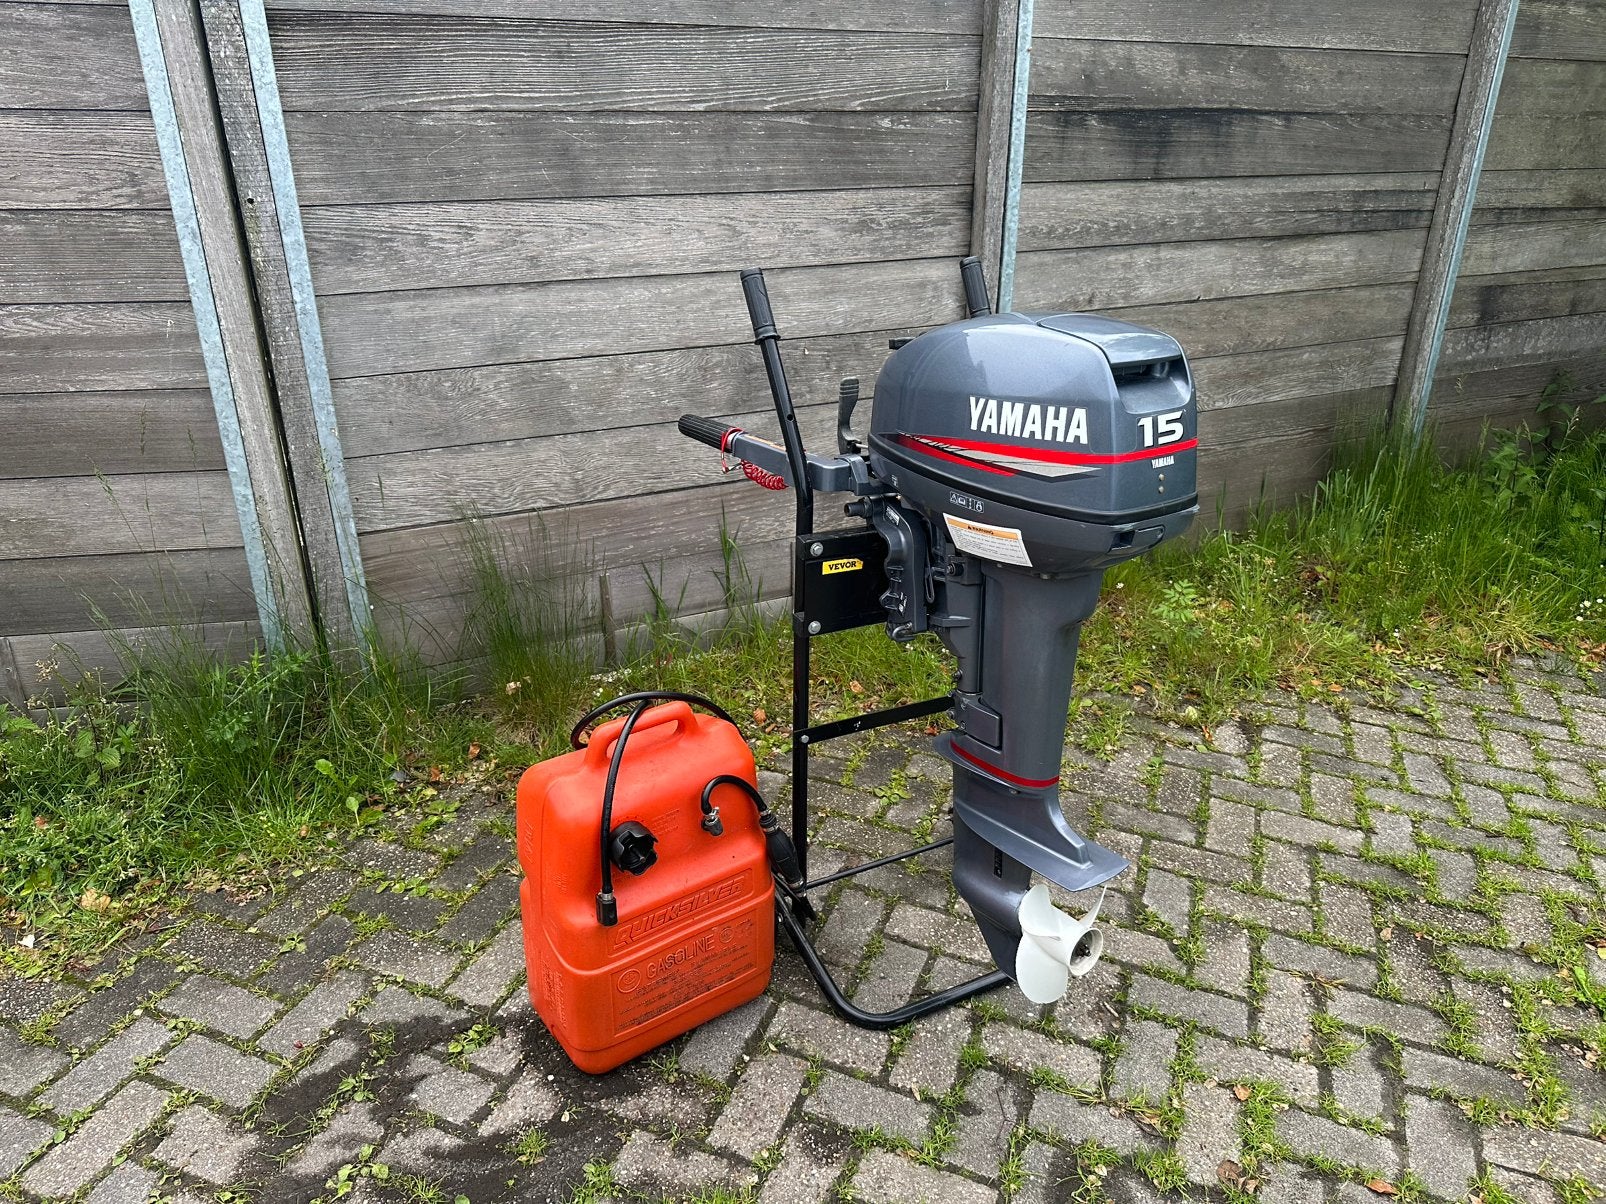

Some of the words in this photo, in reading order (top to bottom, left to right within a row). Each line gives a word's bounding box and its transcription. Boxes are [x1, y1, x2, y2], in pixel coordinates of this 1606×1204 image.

[969, 396, 1088, 445] YAMAHA
[1137, 410, 1184, 448] 15
[1151, 455, 1175, 469] YAMAHA
[828, 560, 857, 571] VEVOR
[613, 876, 745, 949] QUICKSILVER
[645, 935, 716, 978] GASOLINE
